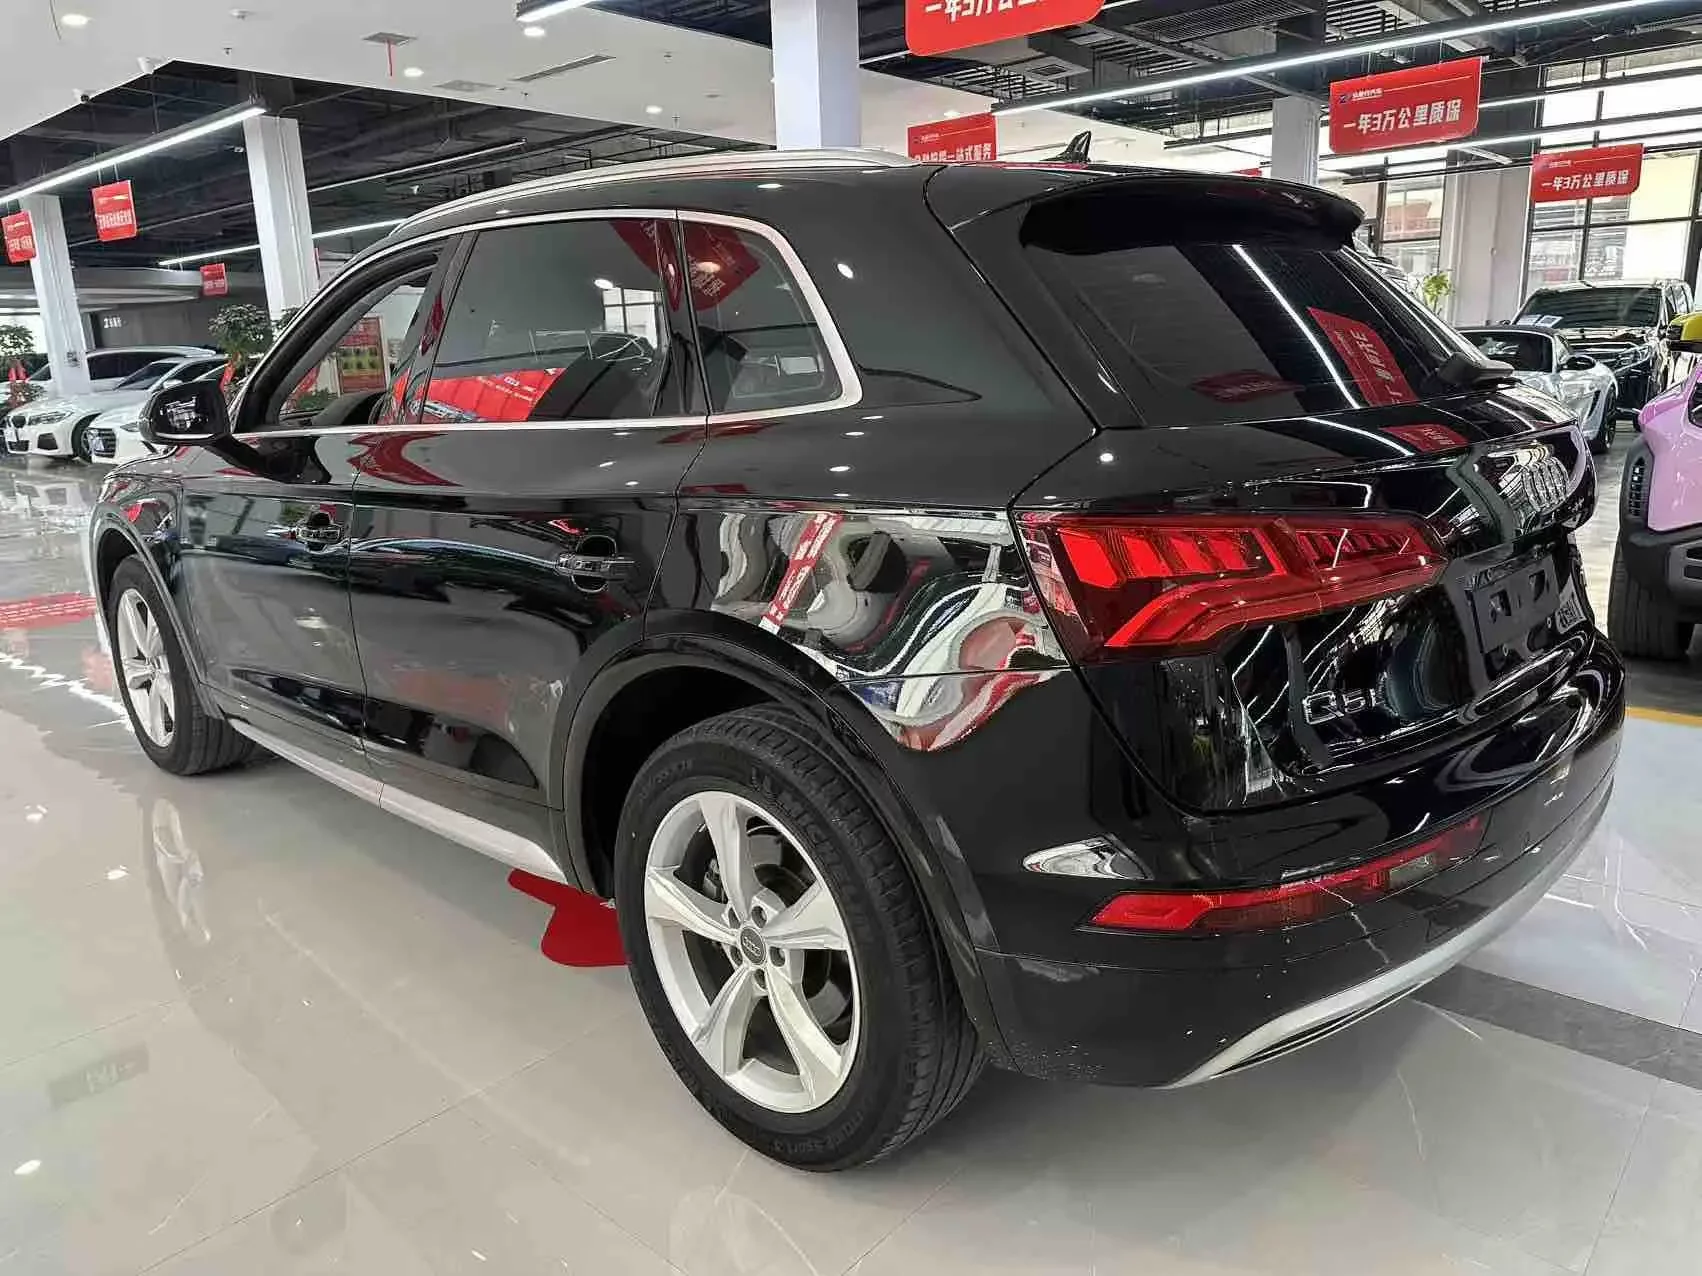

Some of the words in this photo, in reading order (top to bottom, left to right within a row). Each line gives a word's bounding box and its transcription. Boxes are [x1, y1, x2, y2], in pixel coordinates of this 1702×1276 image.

[1343, 99, 1462, 135] 一年3万公里质保
[1541, 169, 1629, 191] 一年3万公里质保
